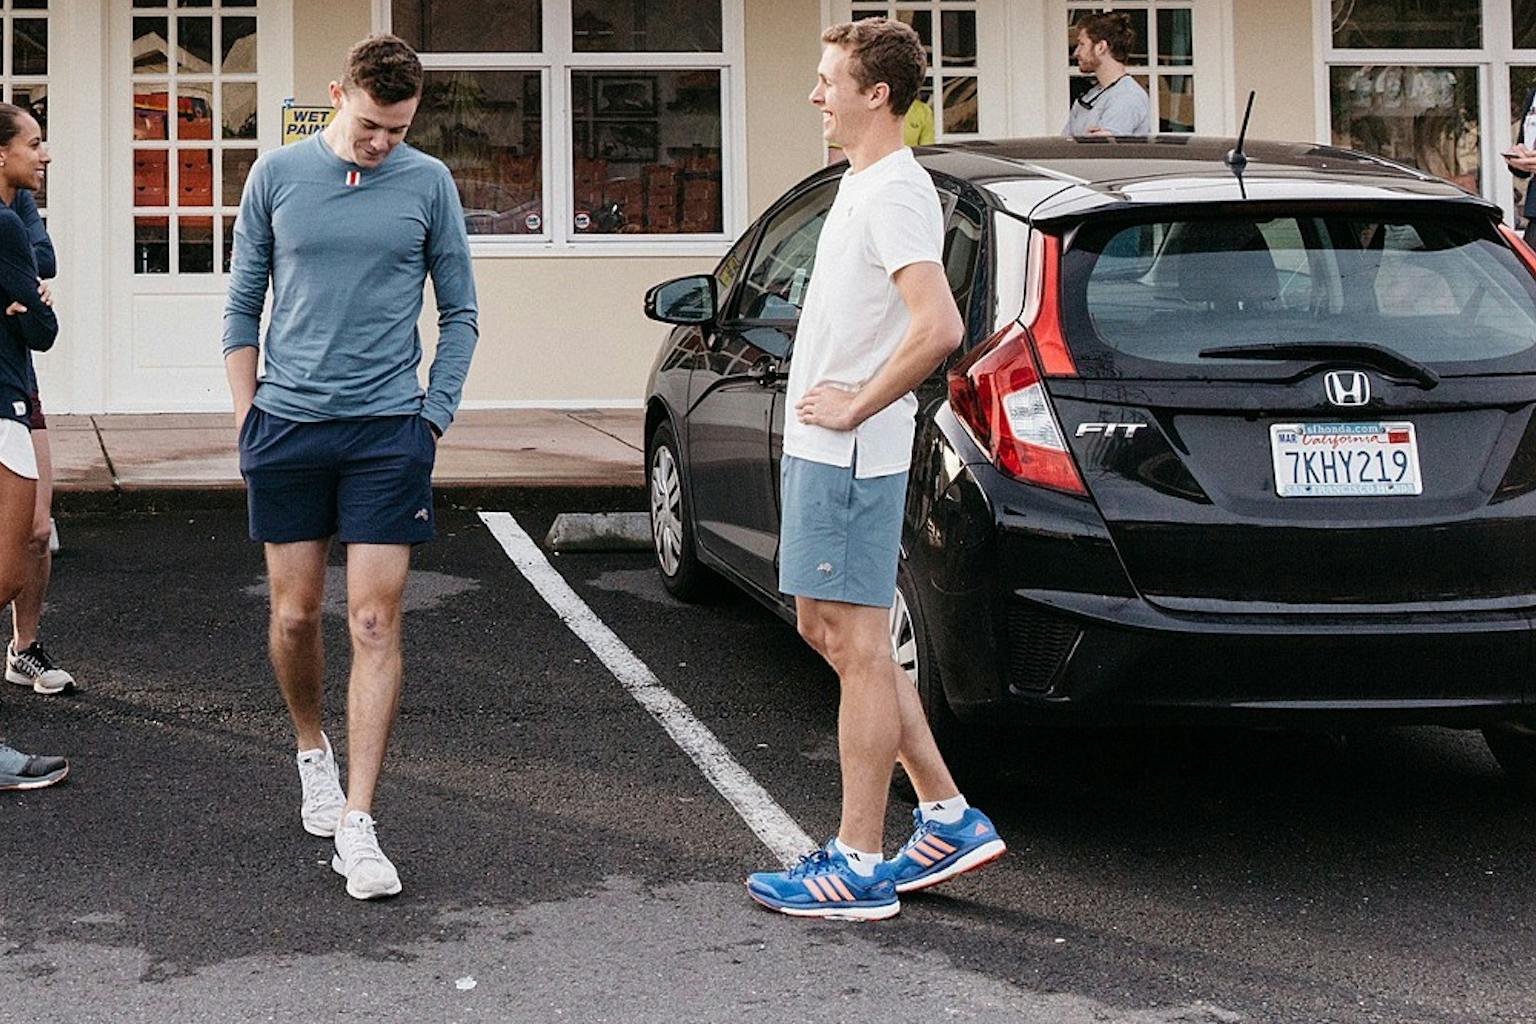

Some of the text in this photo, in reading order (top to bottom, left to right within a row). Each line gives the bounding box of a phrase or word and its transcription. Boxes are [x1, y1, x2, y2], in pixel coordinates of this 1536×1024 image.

[293, 110, 330, 122] WET
[286, 123, 328, 135] PAIN
[1075, 422, 1148, 438] FIT
[1302, 435, 1388, 449] California
[1285, 449, 1409, 484] 7KHY219
